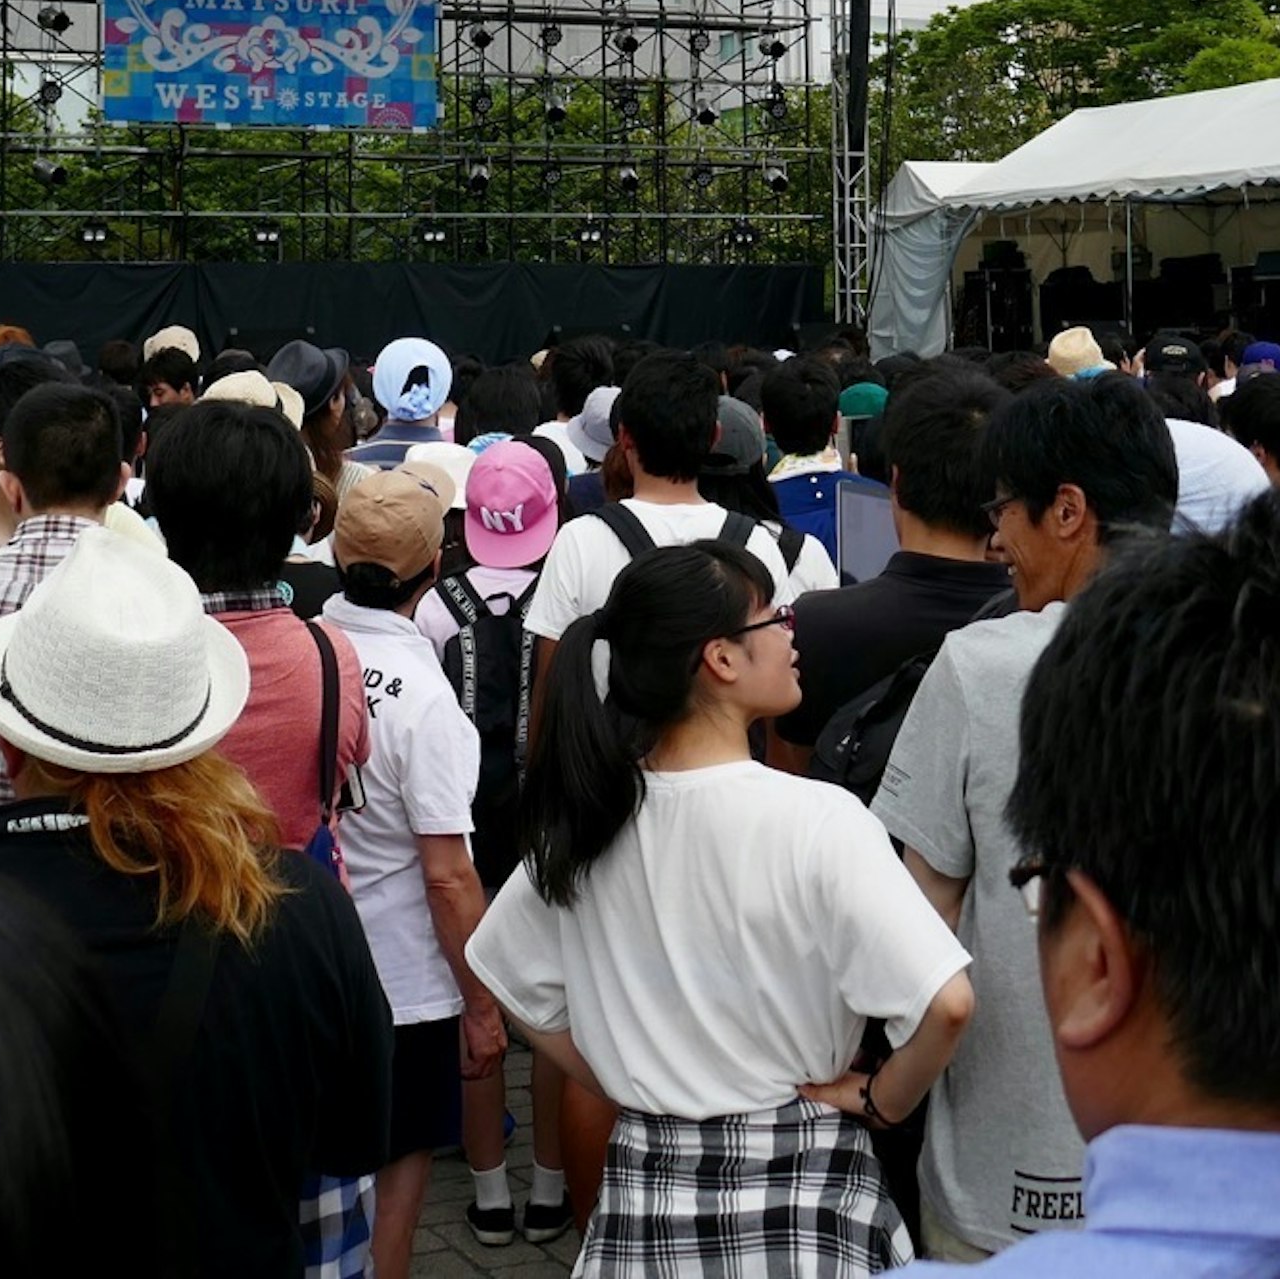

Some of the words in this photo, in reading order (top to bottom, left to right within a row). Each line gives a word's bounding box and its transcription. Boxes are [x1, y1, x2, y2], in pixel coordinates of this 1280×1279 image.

[155, 82, 270, 110] WEST
[304, 90, 388, 109] STAGE
[479, 503, 525, 533] NY
[385, 677, 402, 699] &
